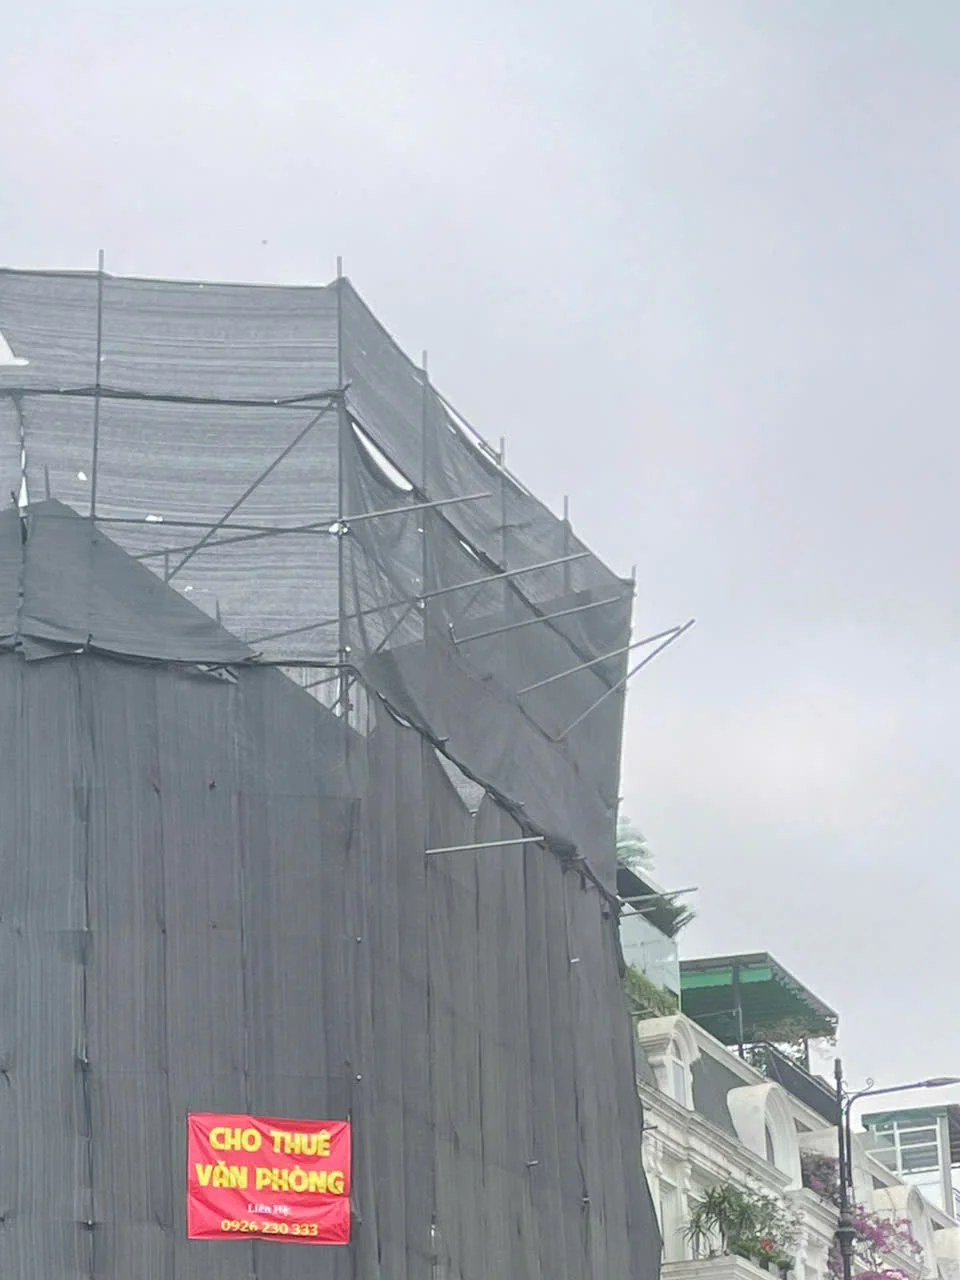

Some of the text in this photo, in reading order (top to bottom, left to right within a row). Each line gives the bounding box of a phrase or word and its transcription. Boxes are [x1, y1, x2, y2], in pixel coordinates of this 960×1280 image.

[209, 1127, 331, 1156] CHO THUÊ
[195, 1160, 344, 1194] VĂN PHÒNG
[221, 1219, 318, 1236] 0926 230 333
